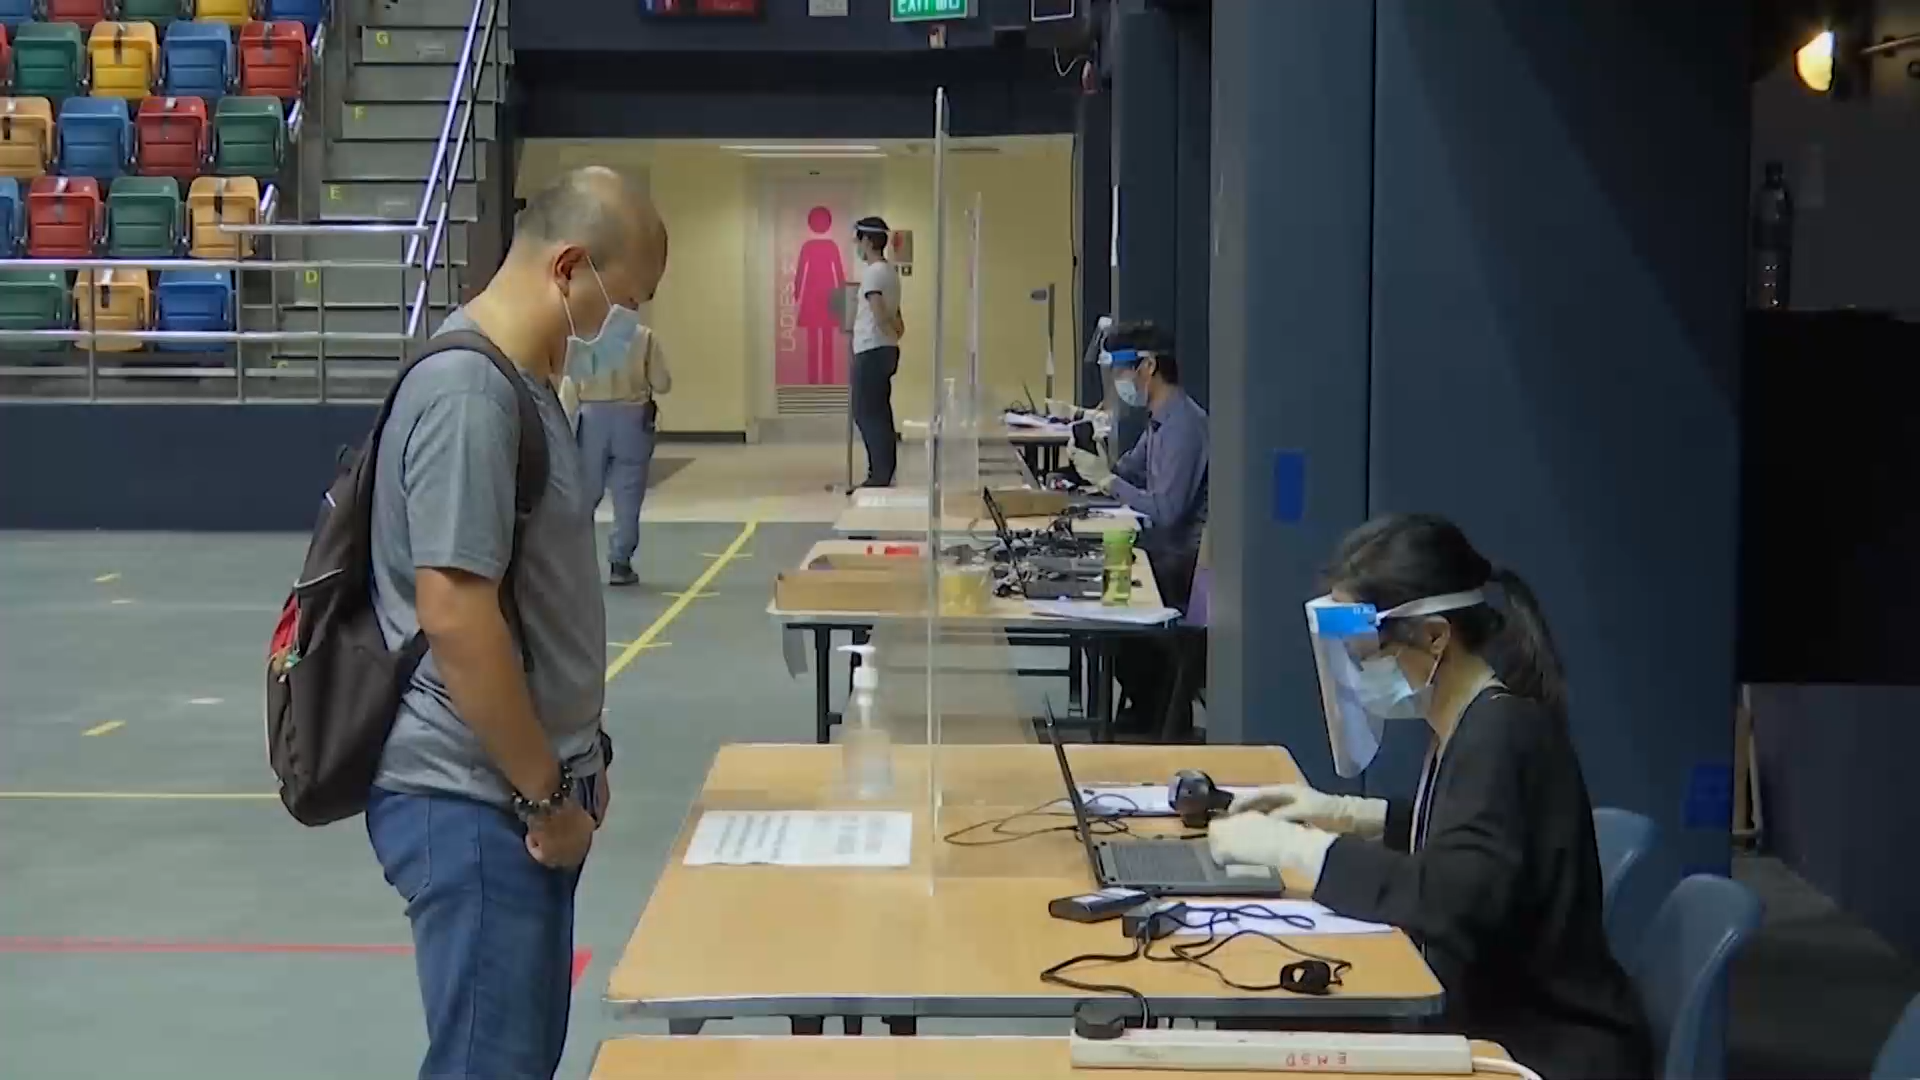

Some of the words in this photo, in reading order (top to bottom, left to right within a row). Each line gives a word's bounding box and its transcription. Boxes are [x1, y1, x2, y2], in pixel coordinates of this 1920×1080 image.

[376, 31, 389, 45] G
[355, 106, 365, 119] F
[330, 185, 342, 200] E
[305, 269, 318, 284] D
